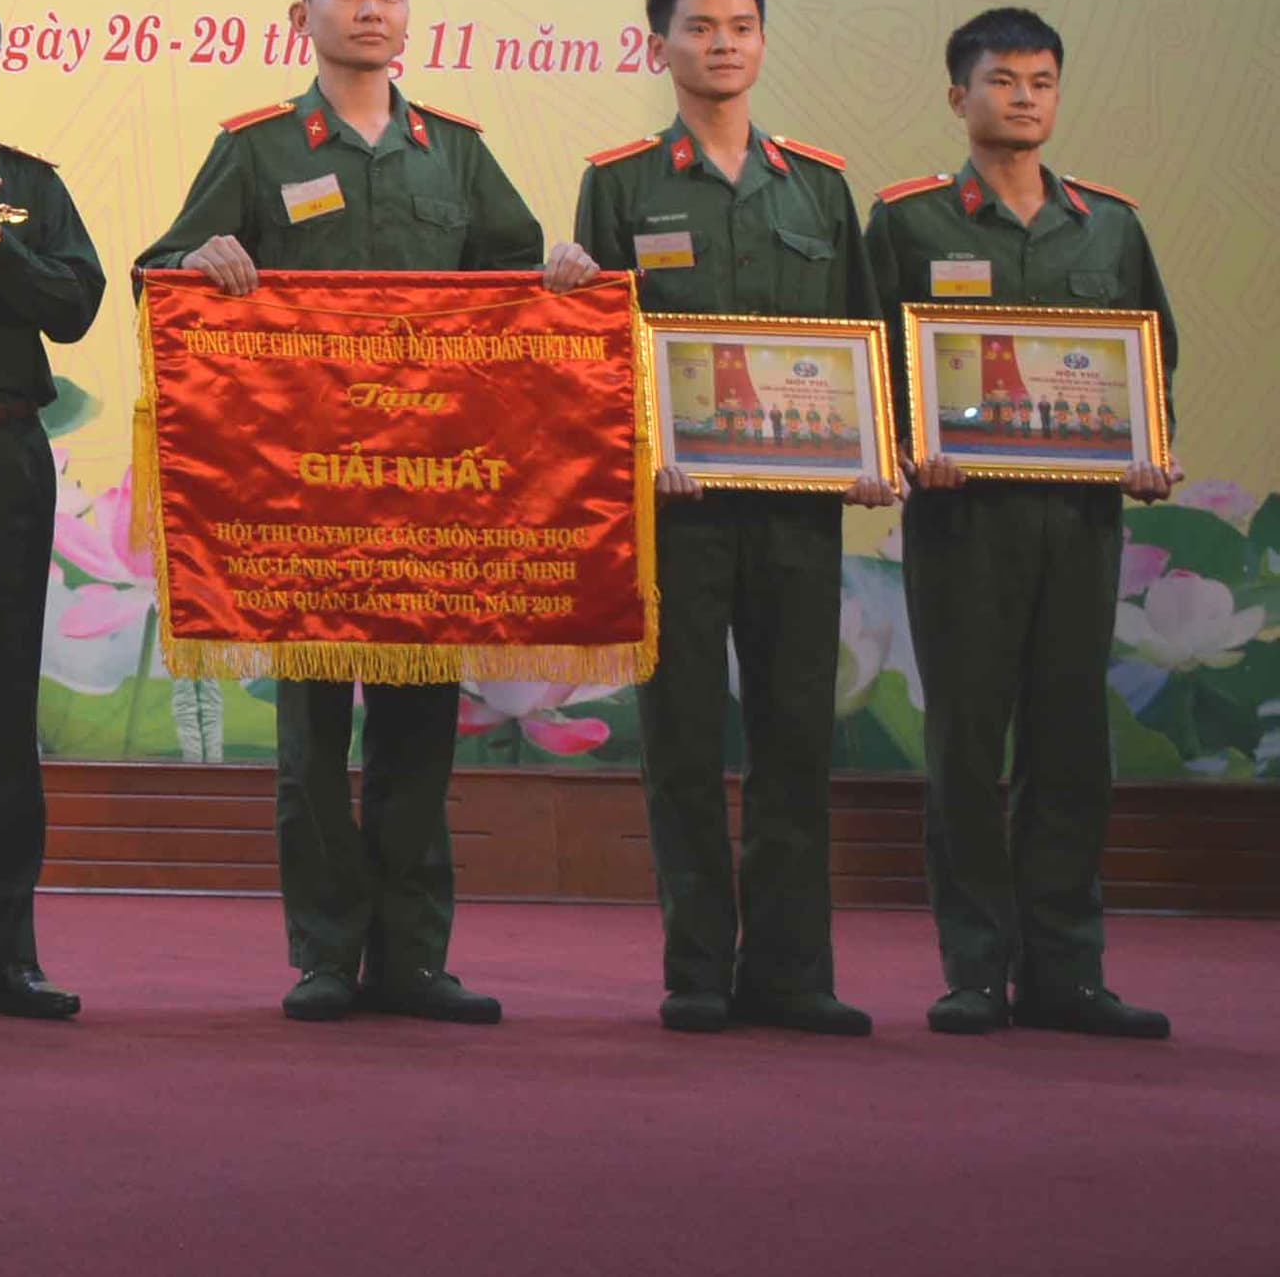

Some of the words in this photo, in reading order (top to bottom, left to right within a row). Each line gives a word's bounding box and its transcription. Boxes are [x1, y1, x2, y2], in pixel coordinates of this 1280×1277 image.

[2, 12, 91, 72] gày
[423, 22, 474, 70] 11
[494, 24, 603, 73] năm
[183, 318, 230, 354] TỔNG
[233, 330, 268, 361] CỤC
[271, 326, 323, 358] CHÍNH
[329, 335, 355, 365] TRỊ
[442, 328, 490, 361] NHÂN
[491, 328, 524, 361] DÂN
[527, 328, 567, 364] VIỆT
[570, 335, 605, 361] NAM
[300, 441, 384, 487] GIẢI
[395, 446, 508, 491] NHẤT
[216, 519, 253, 546] HỘI
[258, 523, 292, 542] THI
[297, 525, 388, 545] OLYMPIC
[391, 523, 430, 546] CÁC
[483, 526, 537, 547] KHOA
[544, 527, 586, 550] HỌC
[522, 561, 576, 580] MINH
[234, 585, 288, 608] TOÀN
[294, 587, 347, 612] QUÂN
[532, 595, 573, 613] 2018
